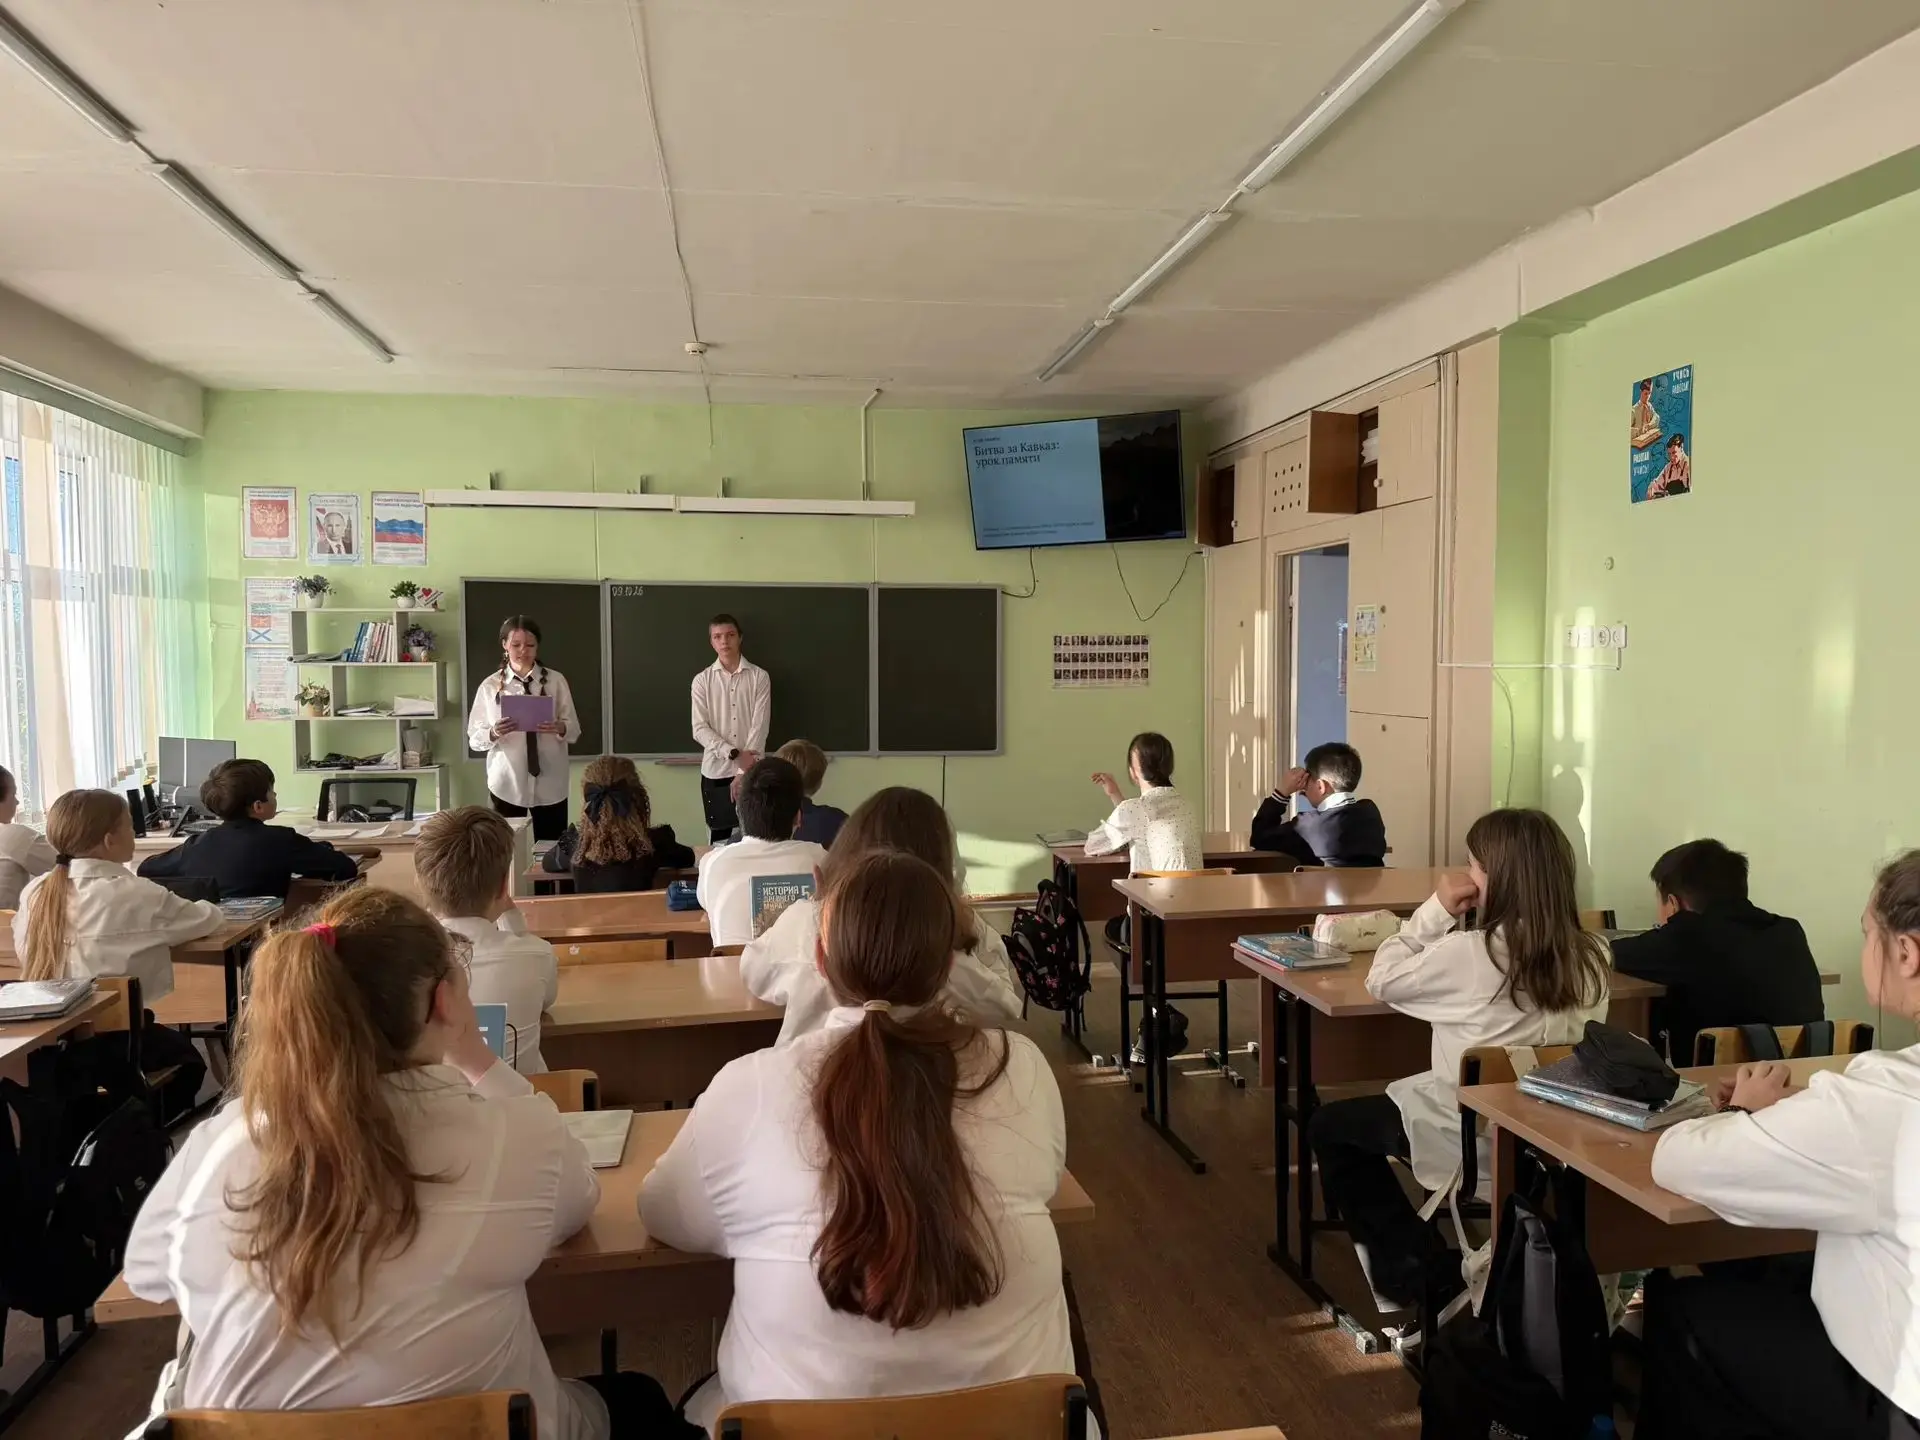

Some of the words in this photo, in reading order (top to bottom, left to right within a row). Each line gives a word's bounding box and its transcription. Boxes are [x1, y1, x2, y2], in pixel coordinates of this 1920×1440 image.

[974, 446, 1005, 456] Битва
[1007, 445, 1018, 453] за
[1020, 441, 1060, 452] Кавказ:
[975, 457, 1000, 468] урок
[1001, 454, 1041, 466] памяти
[763, 886, 799, 895] ИСТОРИЯ
